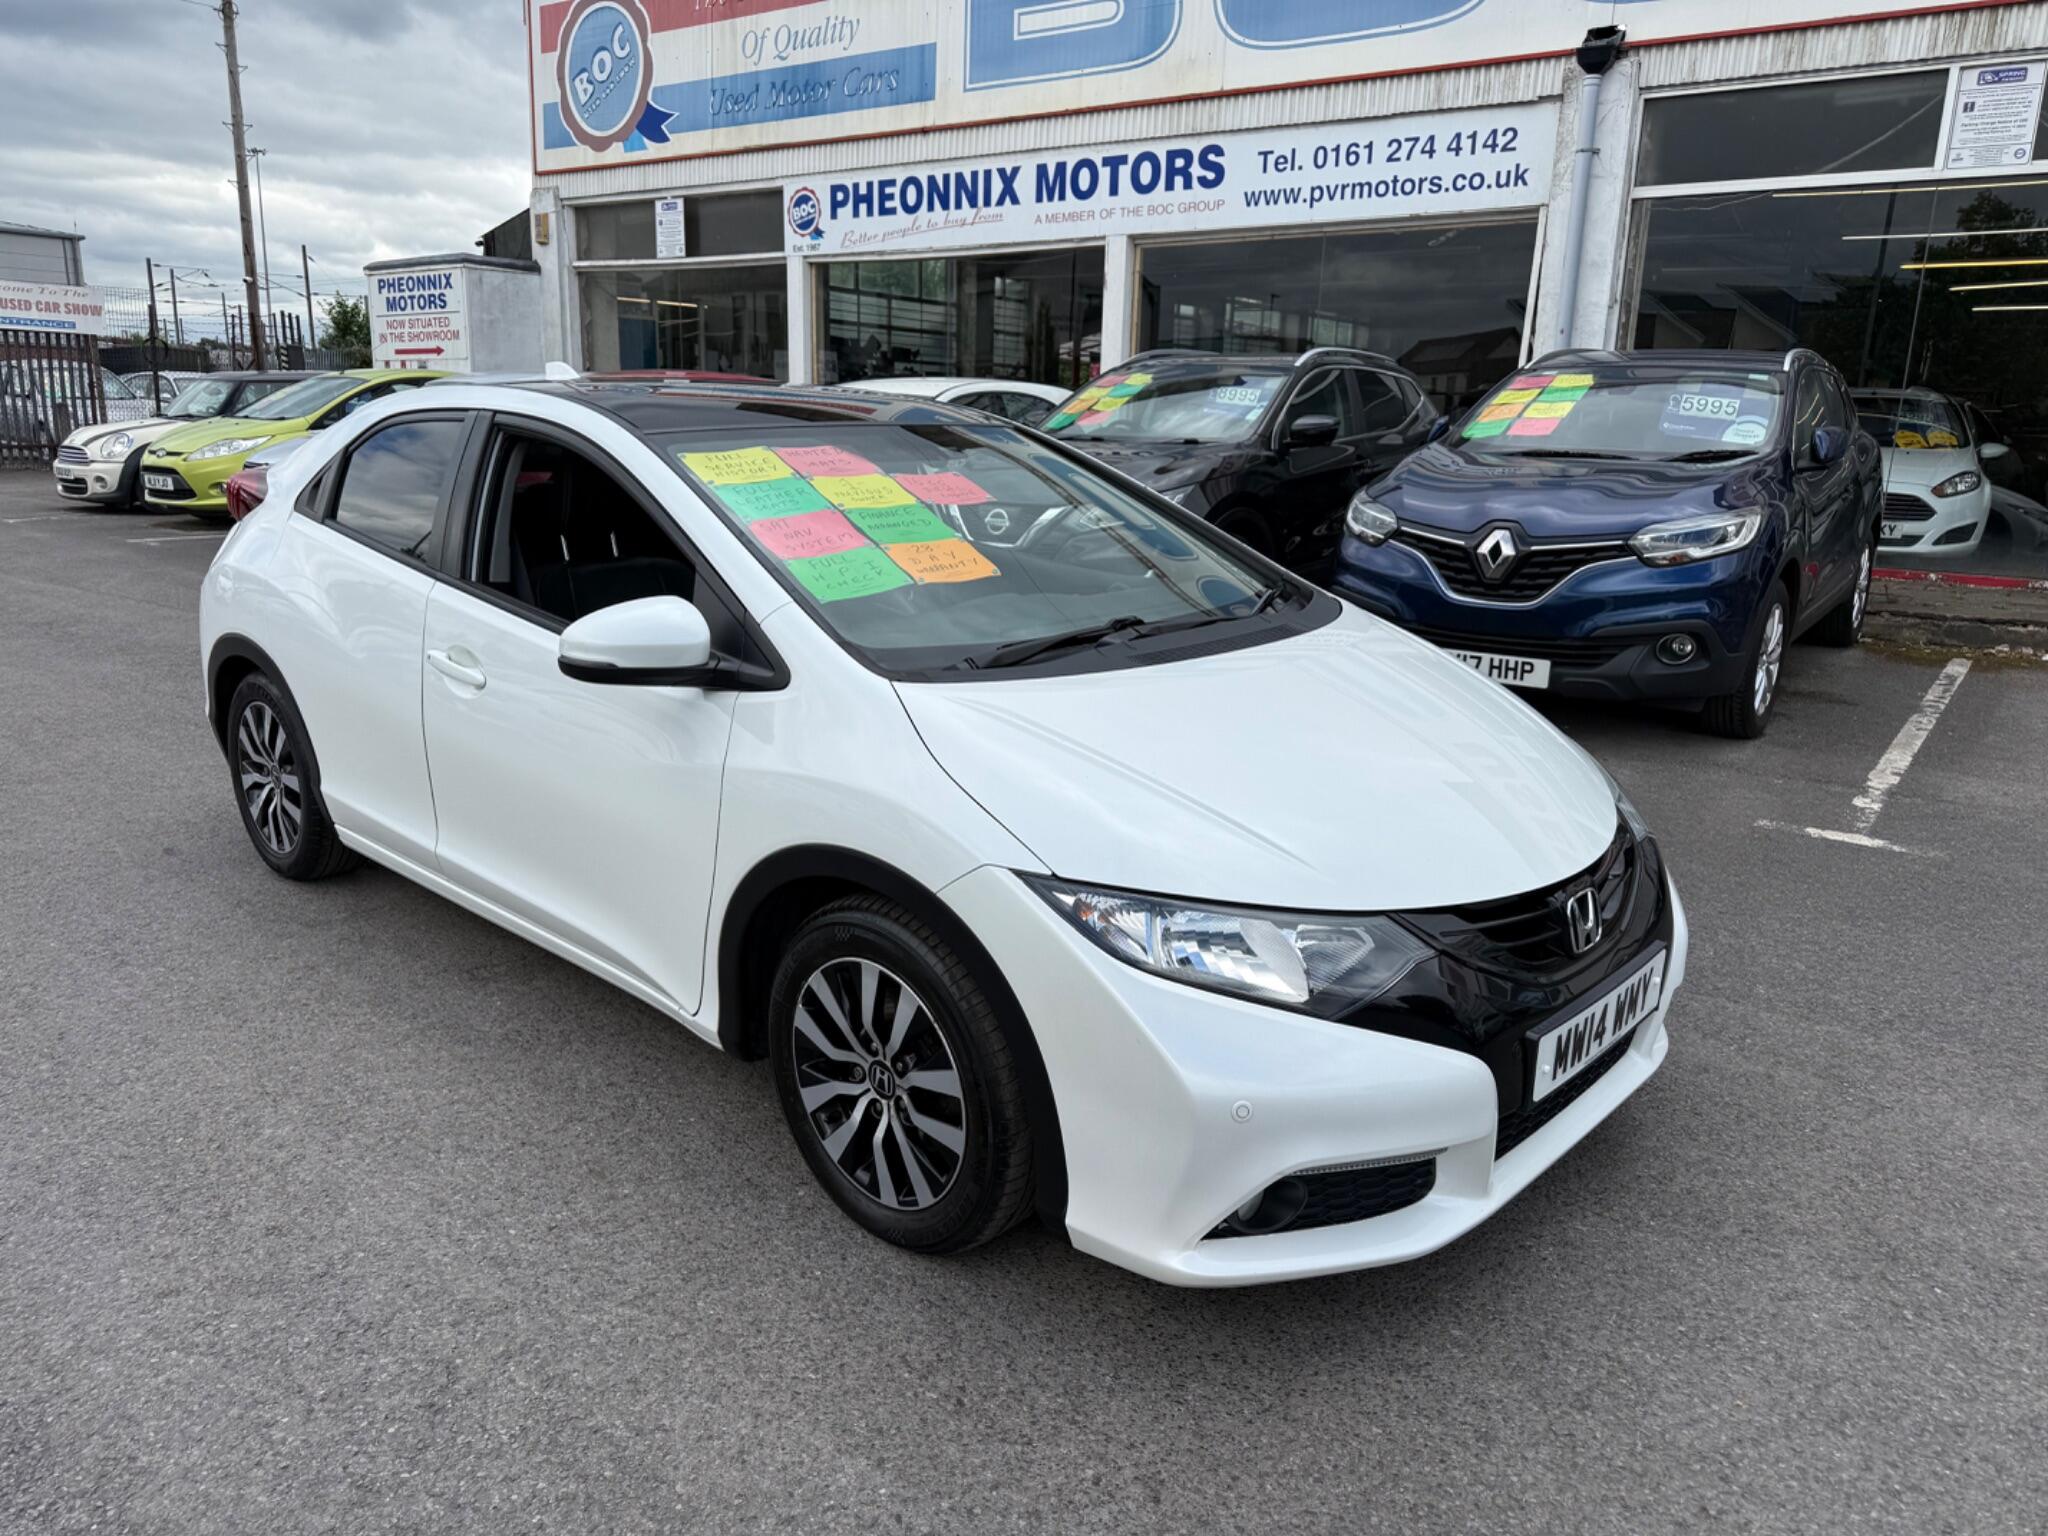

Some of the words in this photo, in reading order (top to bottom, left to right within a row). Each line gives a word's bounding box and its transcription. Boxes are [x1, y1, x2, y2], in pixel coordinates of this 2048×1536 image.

[742, 28, 770, 66] Of
[773, 16, 860, 61] Quality
[573, 22, 631, 107] BOC
[710, 81, 760, 116] Used
[765, 76, 836, 110] Motor
[843, 67, 899, 97] Cars
[1258, 147, 1303, 174] Tel.
[1313, 141, 1374, 169] 0161
[1386, 135, 1436, 163] 274
[1447, 127, 1518, 157] 4142
[830, 165, 1021, 220] PHEONNIX
[1036, 144, 1226, 203] MOTORS
[1244, 163, 1530, 208] www.pvrmotors.co.uk
[793, 201, 816, 220] BOC
[1034, 214, 1043, 224] A
[1045, 209, 1095, 224] MEMBER
[1100, 207, 1116, 219] OF
[1120, 205, 1144, 218] THE
[1147, 203, 1174, 216] BOC
[1177, 200, 1226, 214] GROUP
[840, 230, 879, 249] Better
[882, 215, 922, 241] people
[926, 218, 938, 229] to
[944, 212, 966, 228] buy
[970, 206, 1004, 226] from
[38, 286, 57, 296] To
[63, 288, 89, 298] The
[377, 272, 453, 294] PHEONNIX
[36, 300, 61, 314] CAR
[64, 302, 103, 317] SHOW
[386, 293, 447, 312] MOTORS
[386, 319, 406, 330] NOW
[408, 316, 450, 329] SITUATED
[379, 332, 388, 343] IN
[390, 331, 405, 343] THE
[407, 329, 460, 342] SHOWROOM
[732, 483, 784, 496] FULL
[736, 487, 813, 505] LEATHER
[759, 518, 791, 531] SAT
[783, 527, 813, 540] NAV
[785, 531, 854, 551] SYSTEM
[808, 554, 856, 570] FULL
[827, 568, 885, 590] CHECK
[1488, 657, 1535, 681] HHP
[1551, 1003, 1609, 1081] MW14
